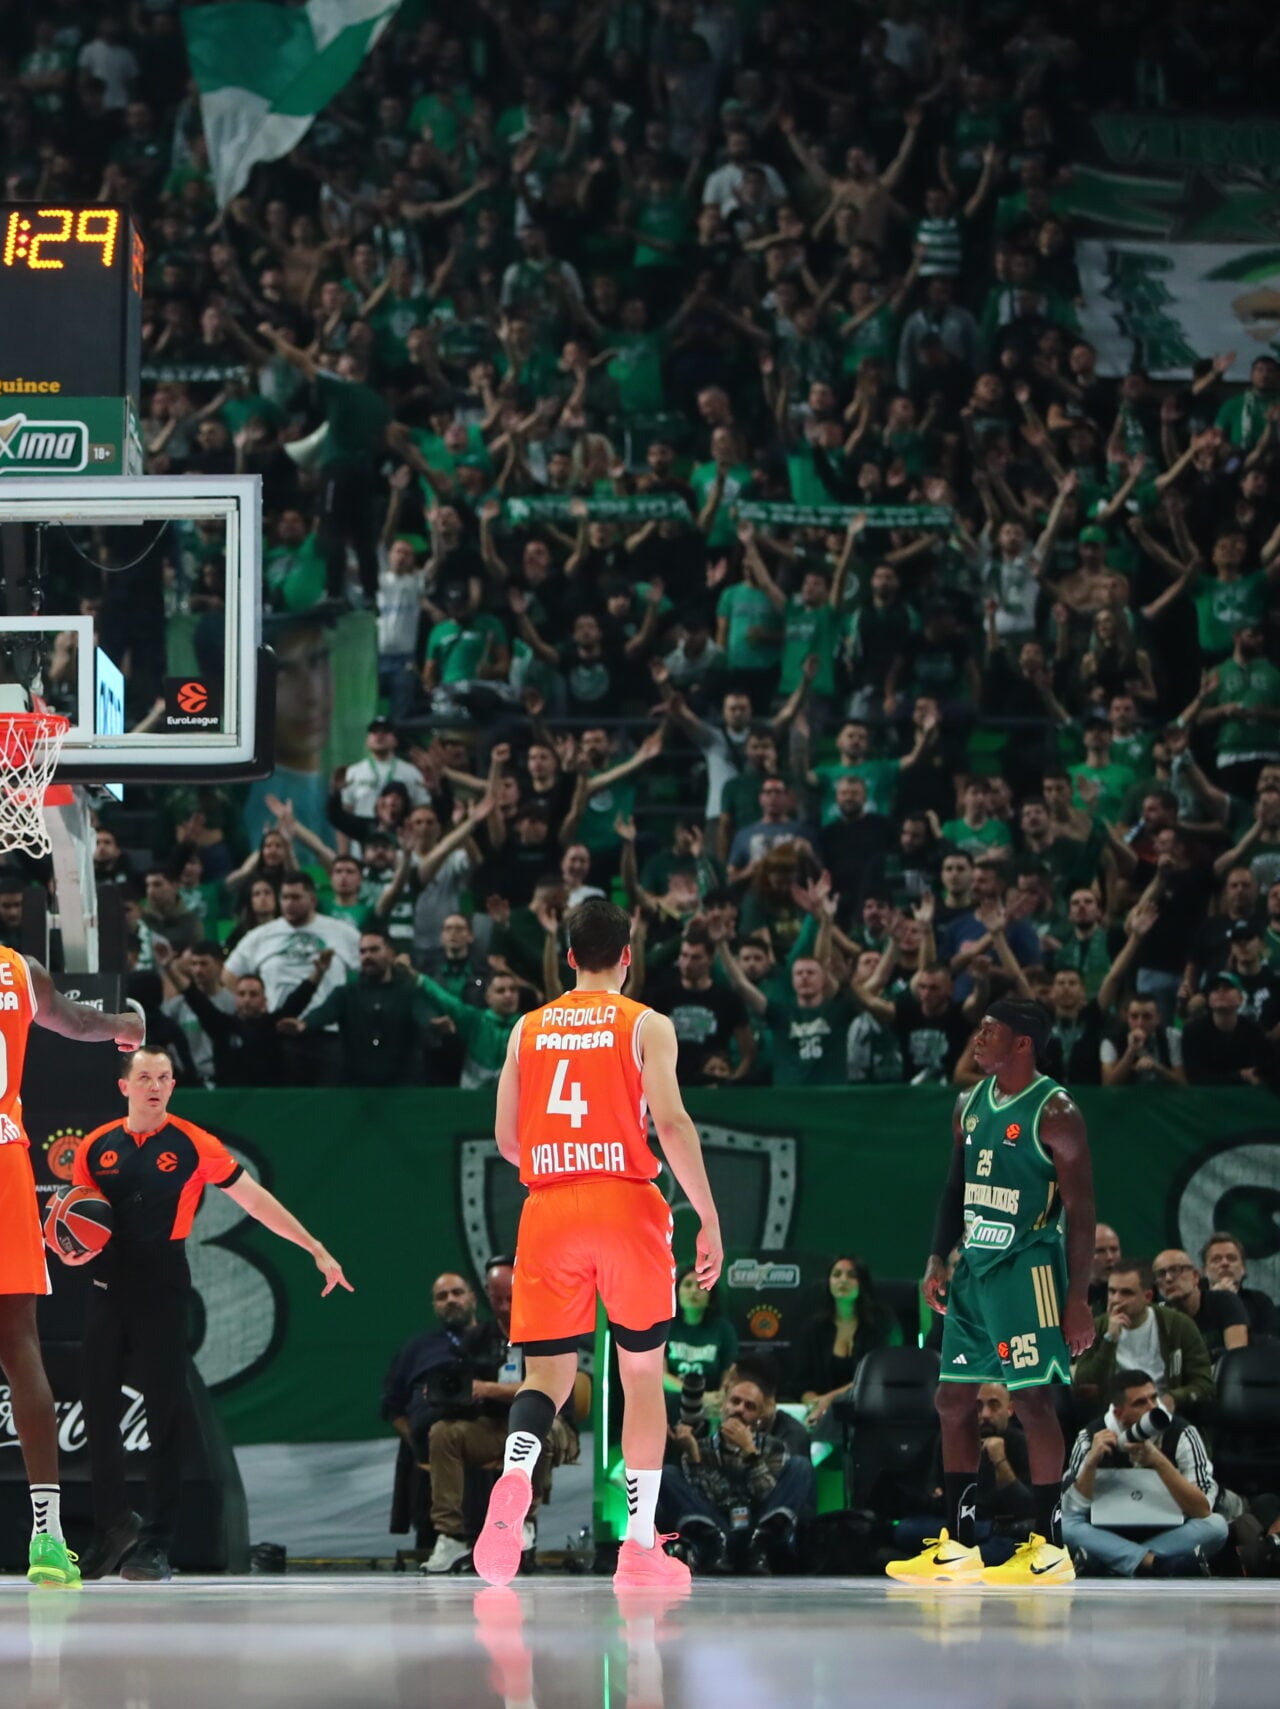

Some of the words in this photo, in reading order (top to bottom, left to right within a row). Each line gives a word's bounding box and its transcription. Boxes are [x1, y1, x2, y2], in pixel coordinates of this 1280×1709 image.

[4, 209, 119, 269] 1:29
[92, 446, 112, 461] 18+
[166, 715, 219, 727] EuroLeague
[541, 1005, 617, 1028] PRADILLA
[535, 1030, 615, 1051] PAMESA
[546, 1059, 589, 1129] 4
[531, 1142, 626, 1176] VALENCIA
[976, 1149, 993, 1177] 25
[1010, 1333, 1039, 1369] 25
